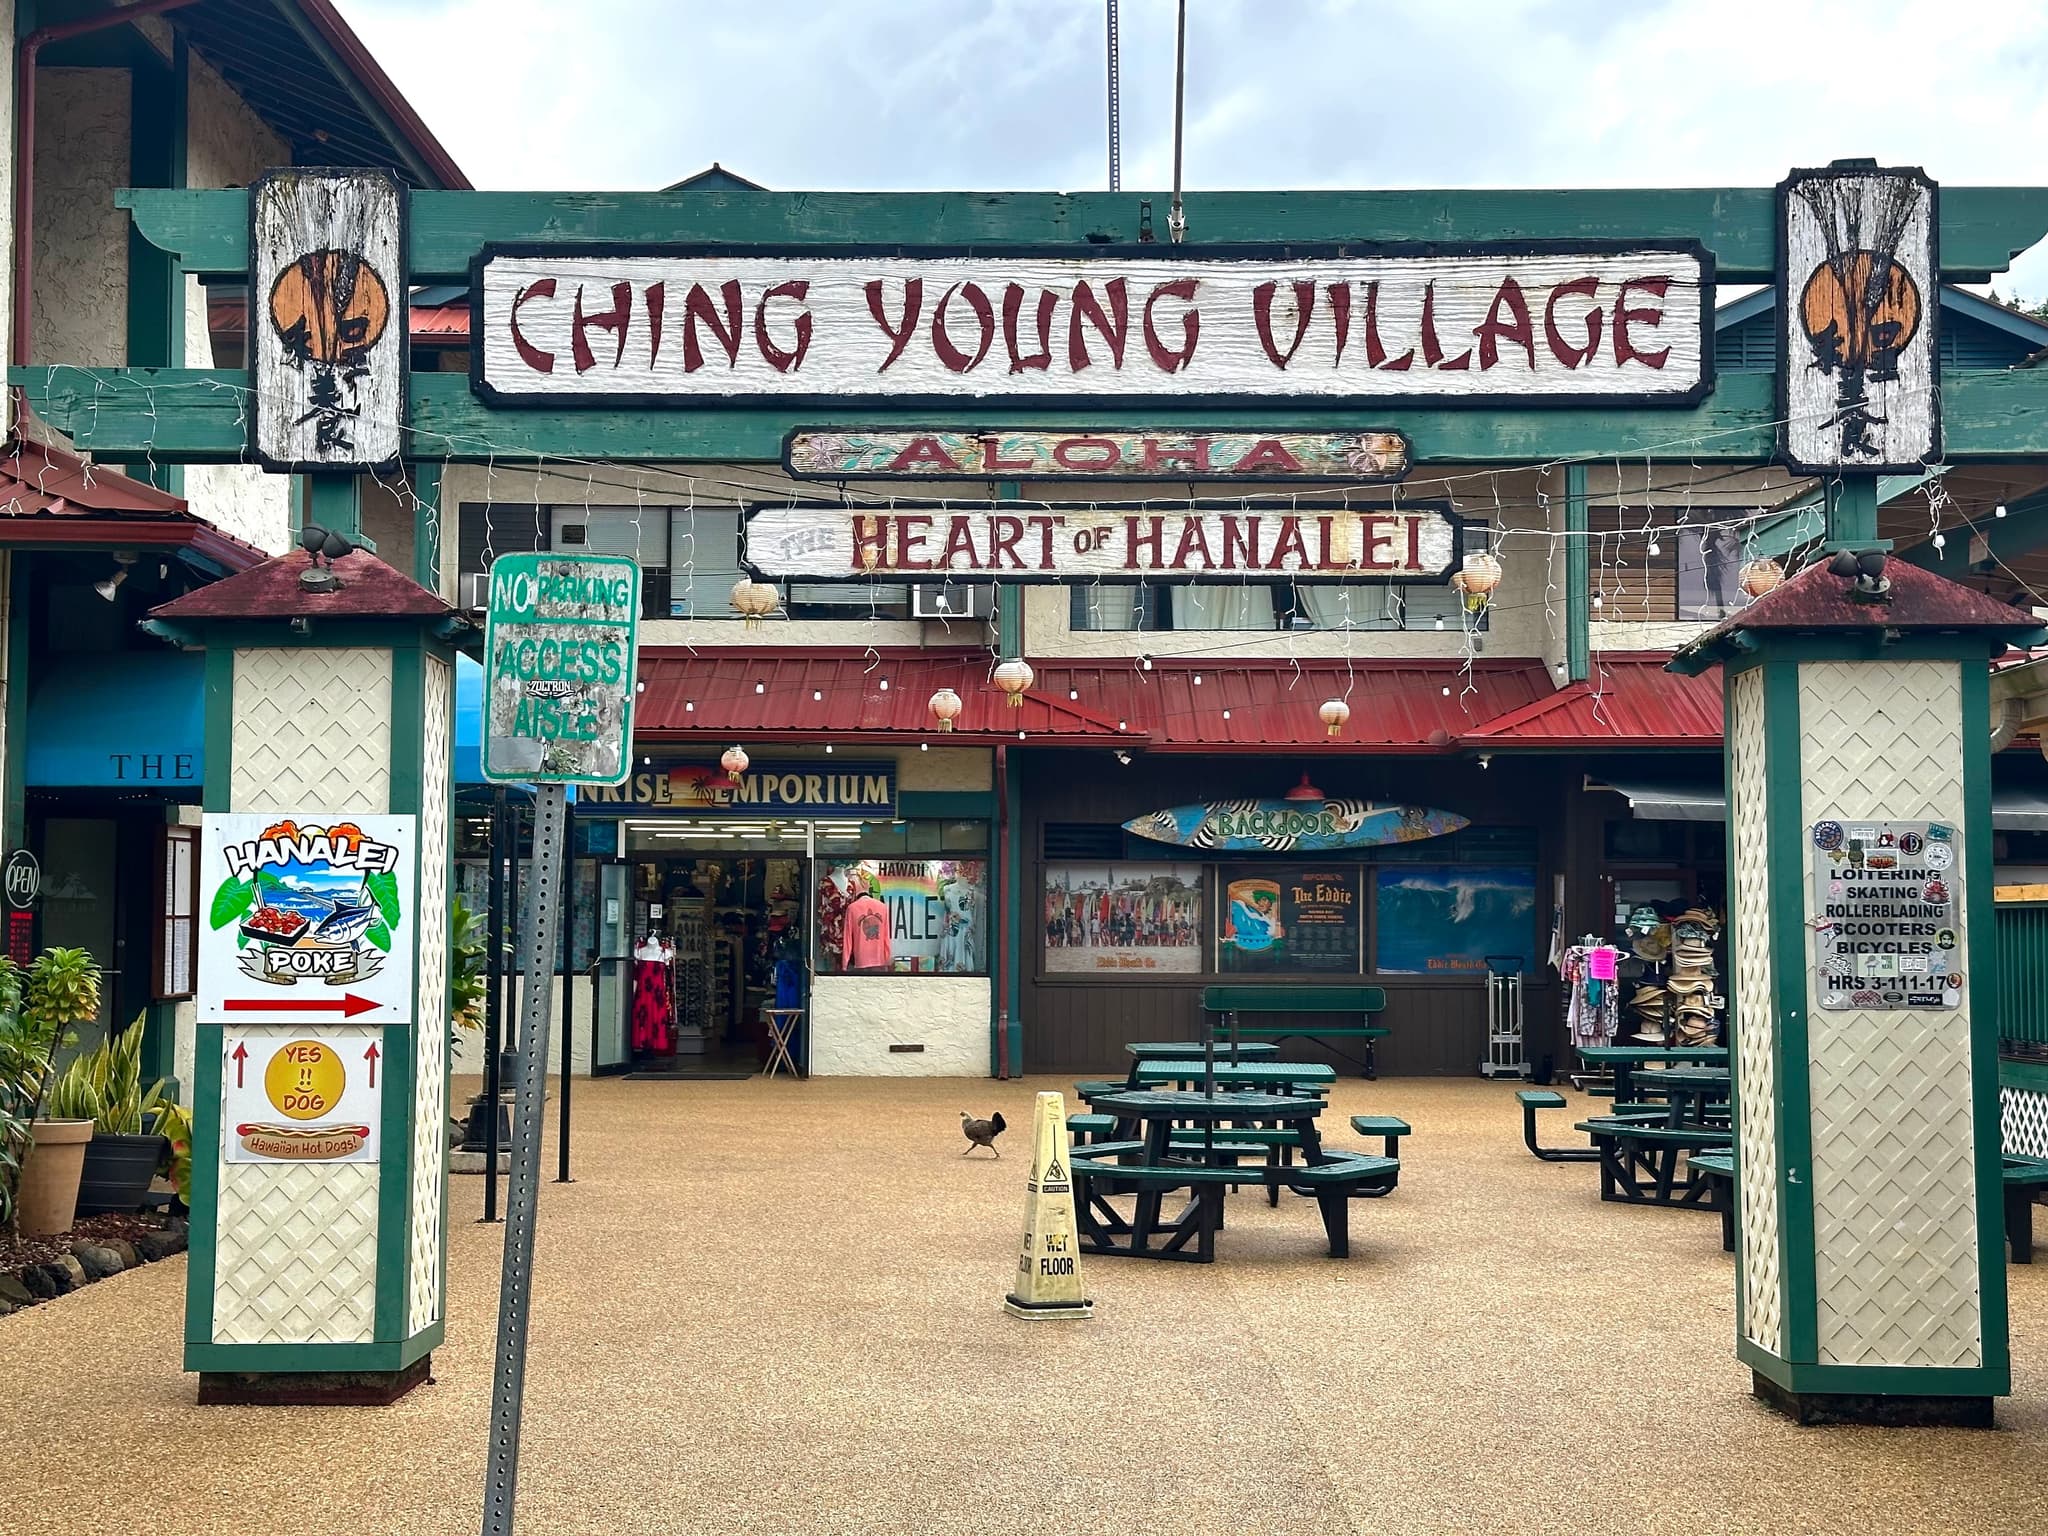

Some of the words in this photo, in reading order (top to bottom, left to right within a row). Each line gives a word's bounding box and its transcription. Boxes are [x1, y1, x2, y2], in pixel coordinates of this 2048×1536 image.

[510, 278, 814, 375] CHING
[864, 276, 1200, 375] YOUNG
[1252, 274, 1673, 373] VILLAGE
[888, 437, 1301, 471] ALOHA
[779, 527, 836, 560] THE
[852, 515, 1066, 569] HEART
[1074, 526, 1113, 554] OF
[1124, 515, 1424, 570] HANALEI
[494, 571, 531, 613] NO
[537, 575, 629, 608] PARKING
[498, 639, 622, 685] ACCESS
[513, 698, 598, 741] AISLE
[110, 753, 195, 780] THE
[719, 773, 890, 805] EMPORIUM
[224, 834, 399, 877] HANALEI
[8, 864, 37, 894] OPEN
[879, 862, 925, 877] HAWAII
[1830, 869, 1941, 880] LOITERING
[1291, 886, 1313, 904] The
[1316, 883, 1352, 905] Eddie
[1847, 886, 1918, 899] SKATING
[1826, 904, 1944, 918] ROLLERBLADING
[1832, 923, 1937, 936] SCOOTERS
[1836, 941, 1934, 954] BICYCLES
[267, 950, 356, 974] POKE
[1828, 976, 1866, 990] HRS
[1871, 975, 1947, 990] 3-111-17
[286, 1047, 322, 1063] YES
[283, 1094, 325, 1111] DOG
[251, 1137, 299, 1154] Hawaiian
[302, 1141, 323, 1154] Hot
[325, 1136, 358, 1152] Dogs!
[1043, 1184, 1068, 1192] CAUTION
[1046, 1234, 1068, 1252] WET
[1041, 1257, 1074, 1276] FLOOR
